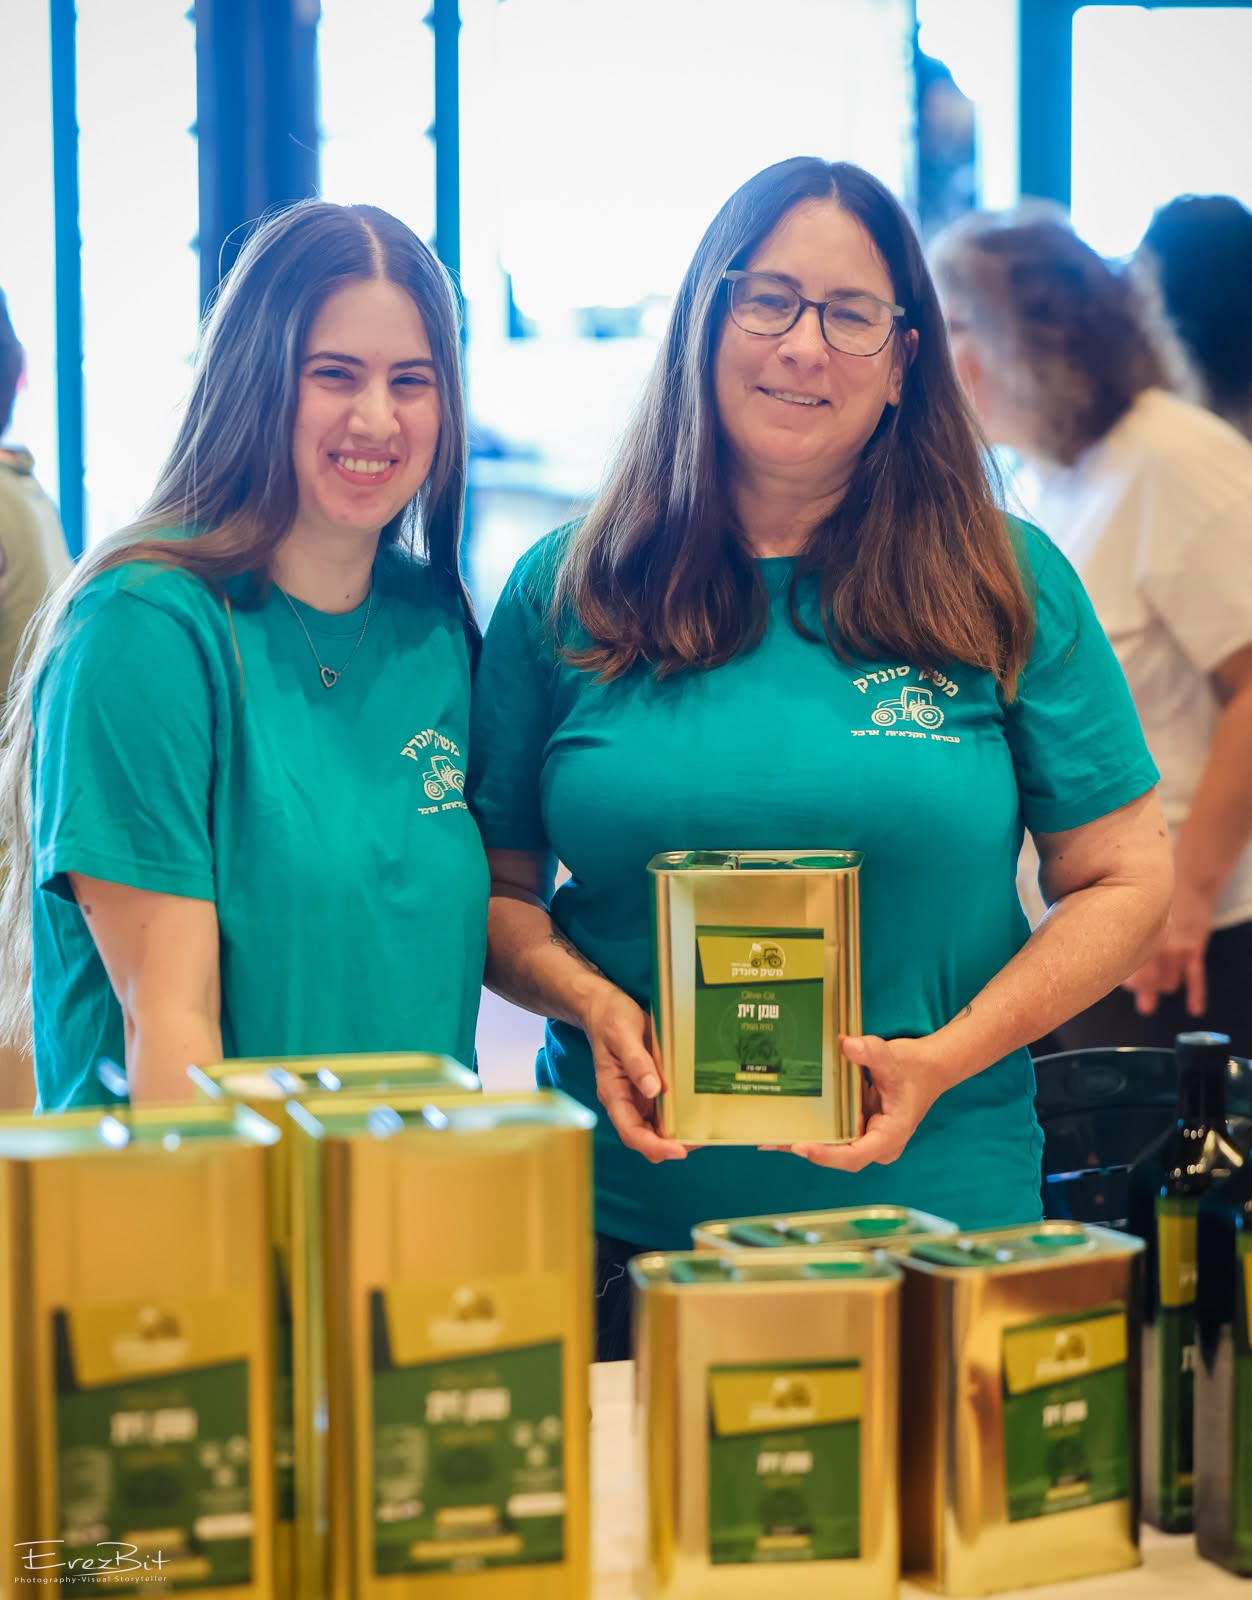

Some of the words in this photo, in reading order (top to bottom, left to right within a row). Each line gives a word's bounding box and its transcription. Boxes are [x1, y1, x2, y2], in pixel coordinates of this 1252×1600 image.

[853, 665, 910, 694] סונדק
[885, 729, 926, 739] חקלאיות
[737, 1003, 756, 1018] זית
[758, 1004, 779, 1021] שמן
